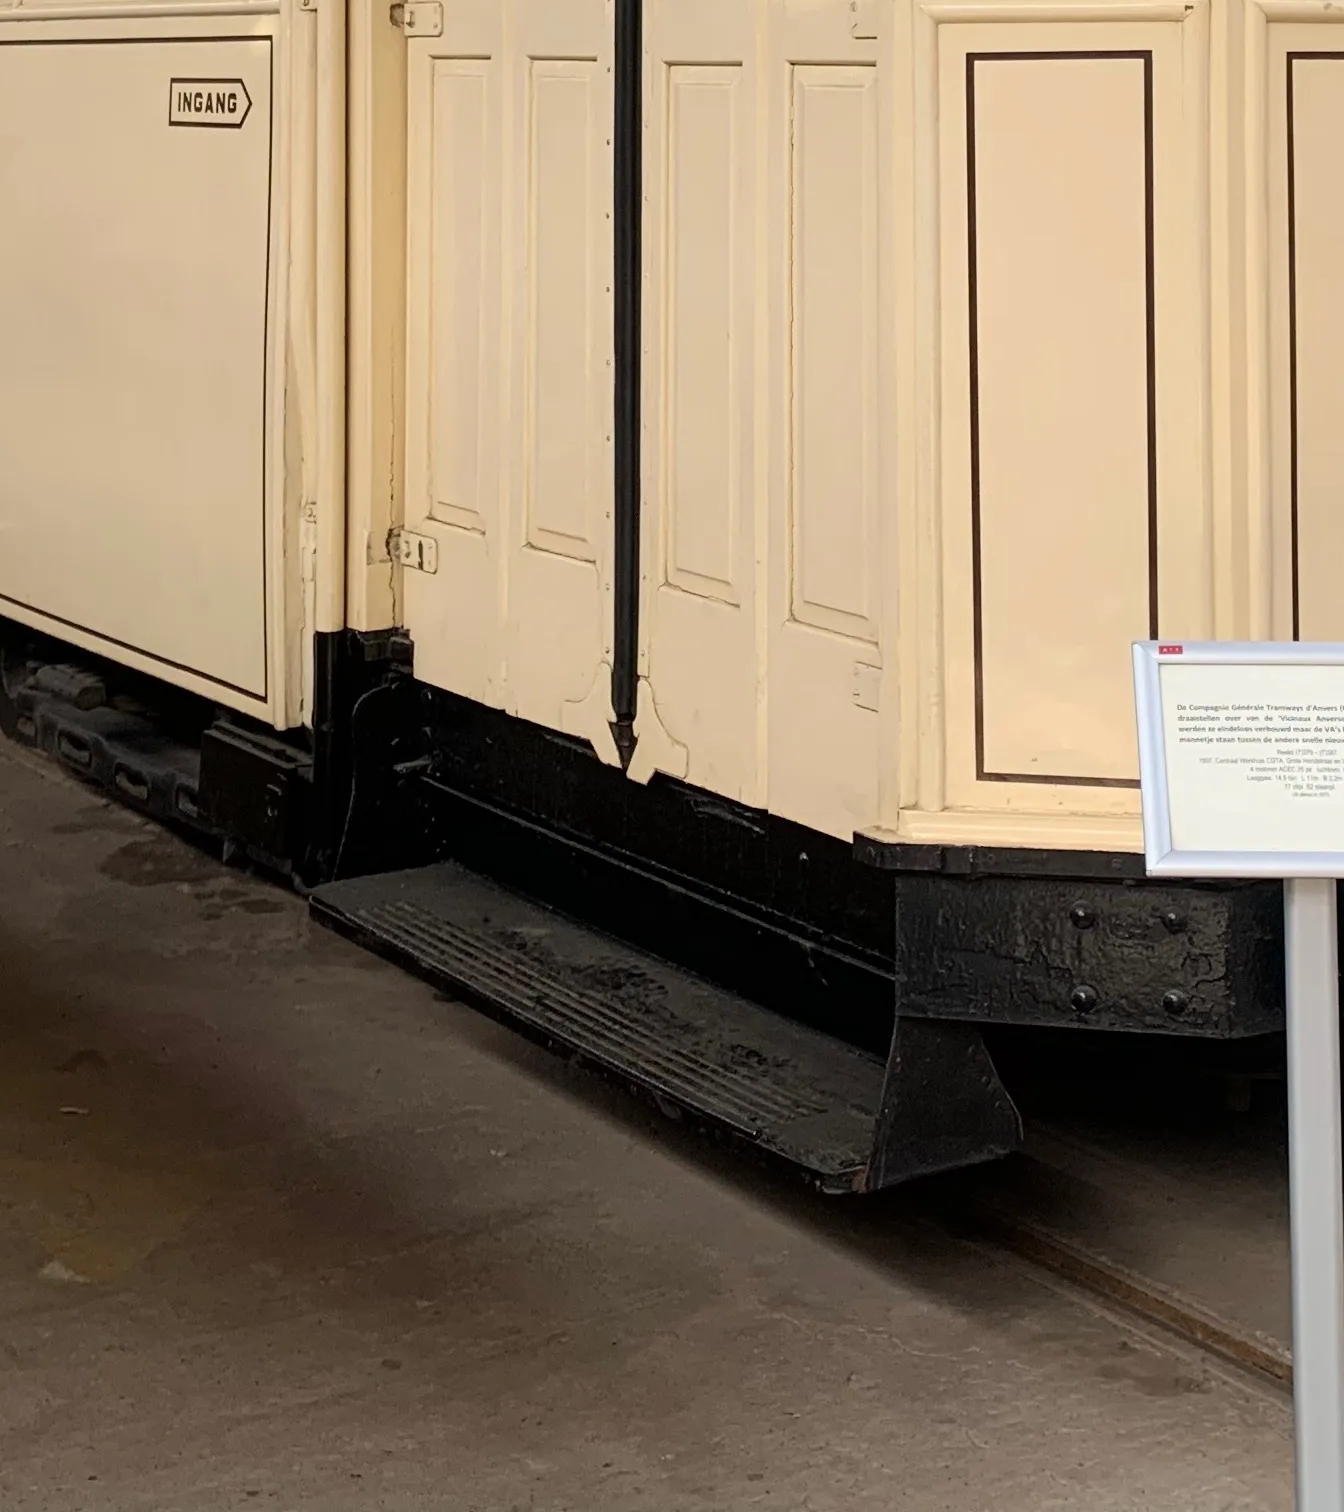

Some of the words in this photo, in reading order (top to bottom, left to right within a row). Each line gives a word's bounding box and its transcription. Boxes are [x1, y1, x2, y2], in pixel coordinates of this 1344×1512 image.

[177, 90, 239, 116] INGANG
[1189, 704, 1230, 714] Compagnie
[1266, 704, 1304, 714] Tramways
[1263, 736, 1273, 744] de
[1274, 736, 1300, 744] andere
